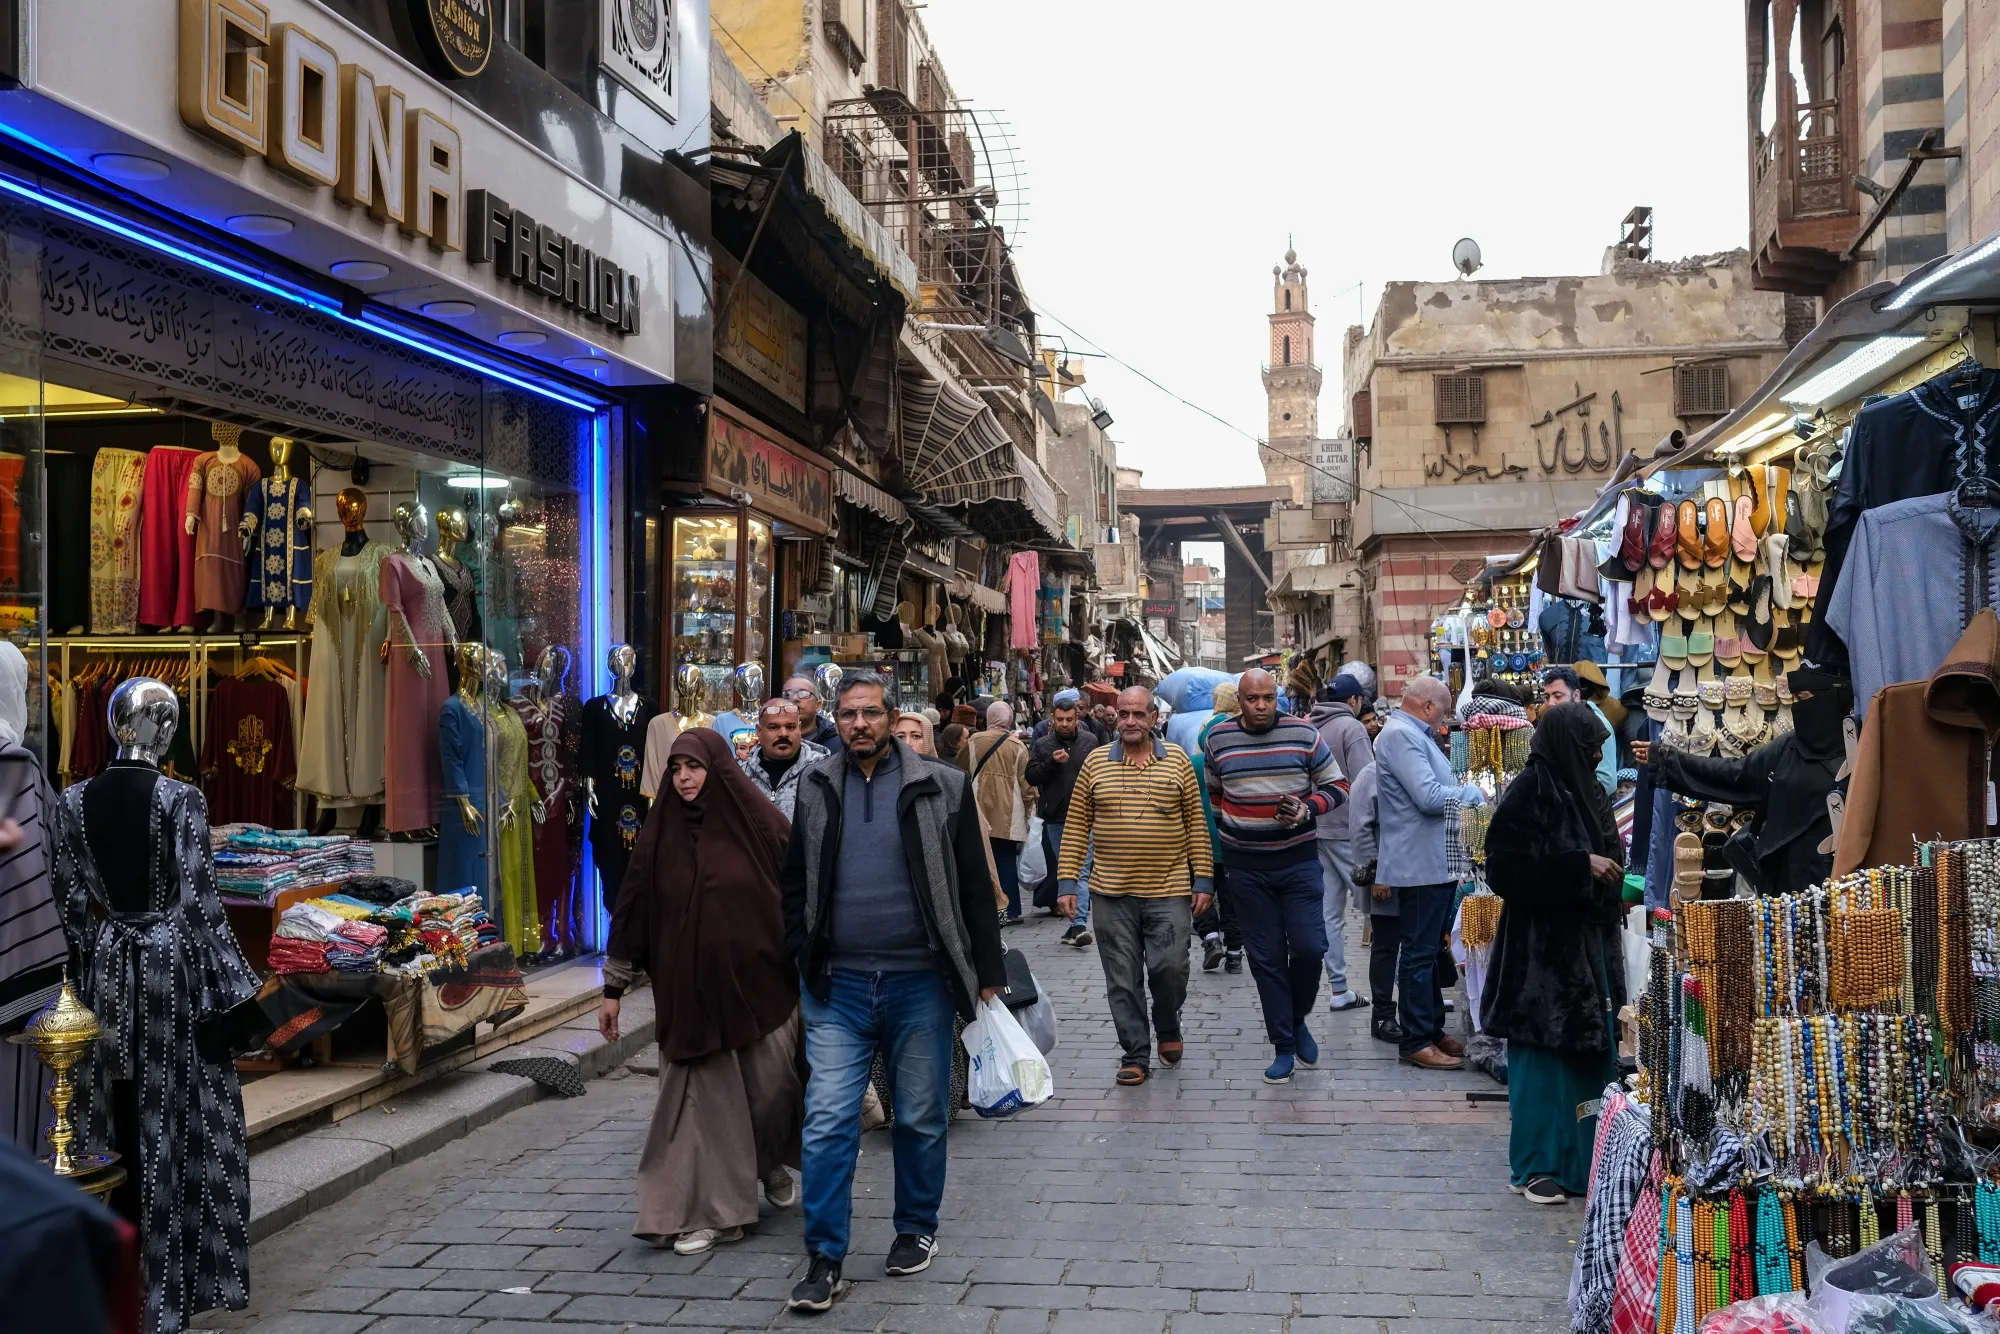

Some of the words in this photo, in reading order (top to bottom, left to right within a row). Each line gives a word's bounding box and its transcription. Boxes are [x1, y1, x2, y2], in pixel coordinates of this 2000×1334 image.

[178, 0, 463, 252] GONA
[466, 188, 641, 336] FASHION
[1316, 455, 1325, 463] EL
[1326, 455, 1348, 463] ATTAR
[1321, 443, 1343, 452] KHEDR
